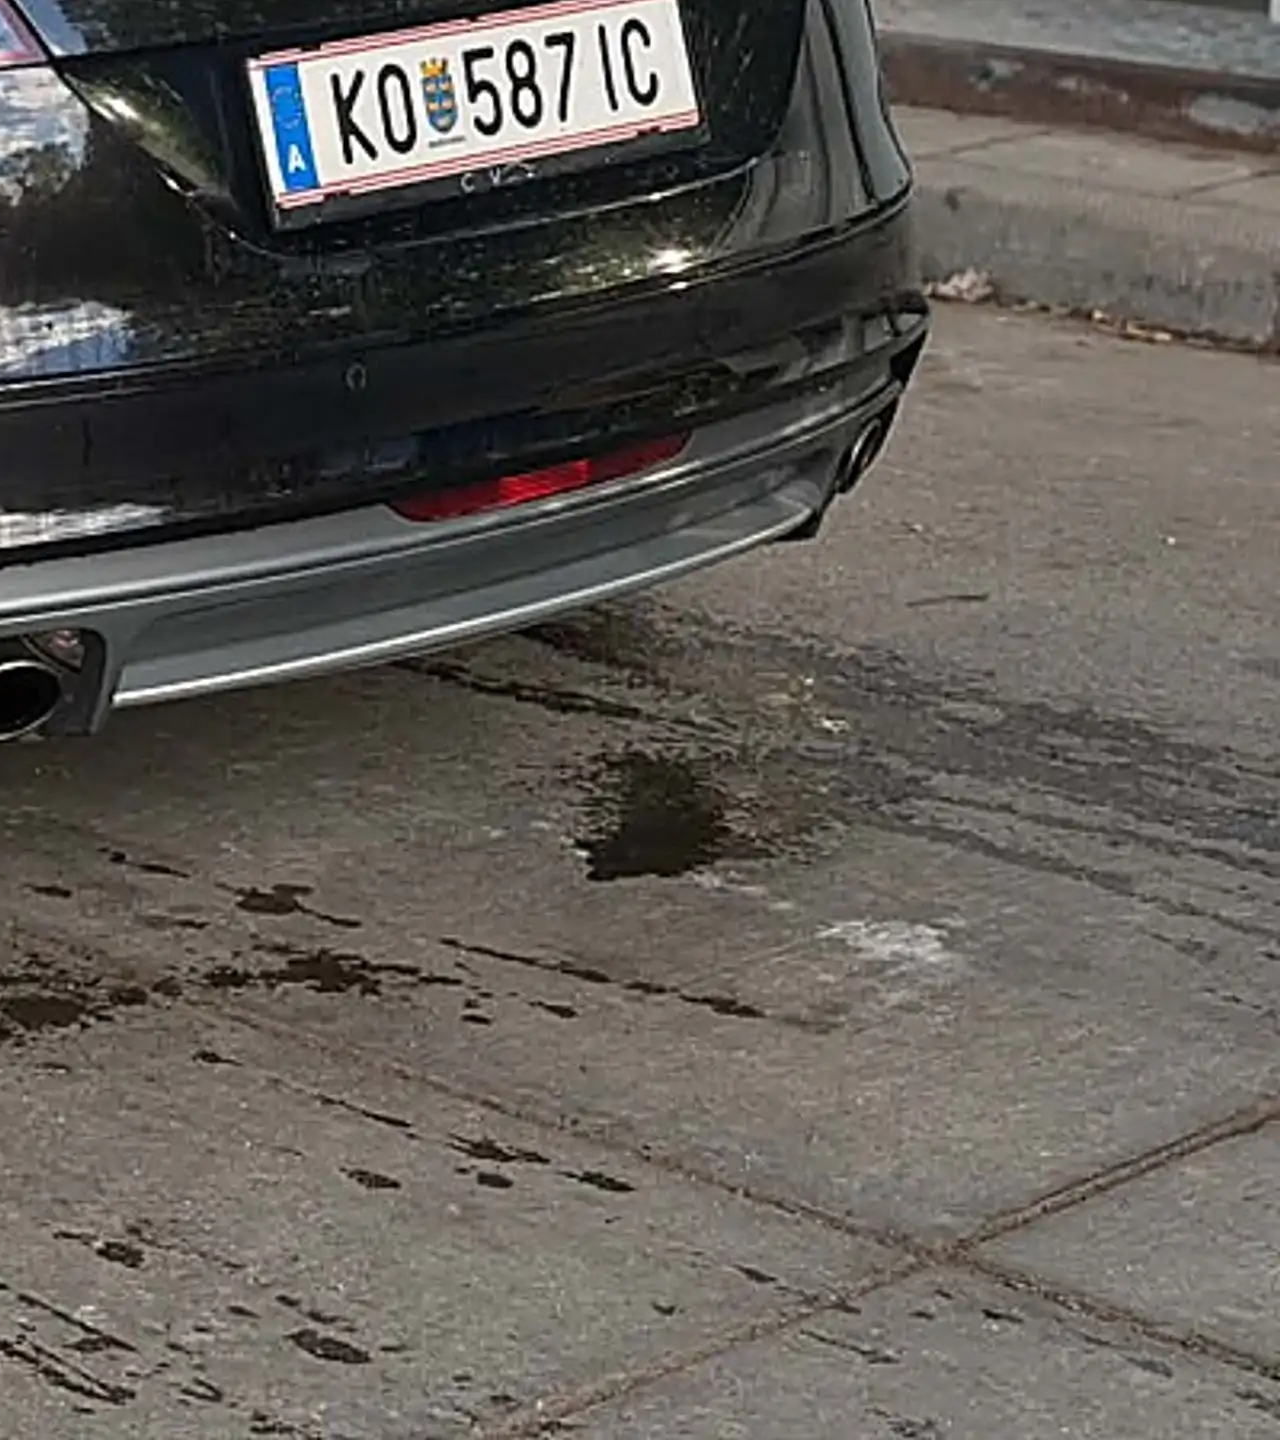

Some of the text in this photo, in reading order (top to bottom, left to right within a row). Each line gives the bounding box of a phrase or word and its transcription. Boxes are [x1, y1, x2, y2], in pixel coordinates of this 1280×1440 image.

[330, 17, 658, 164] KO 587 IC
[288, 144, 306, 174] A
